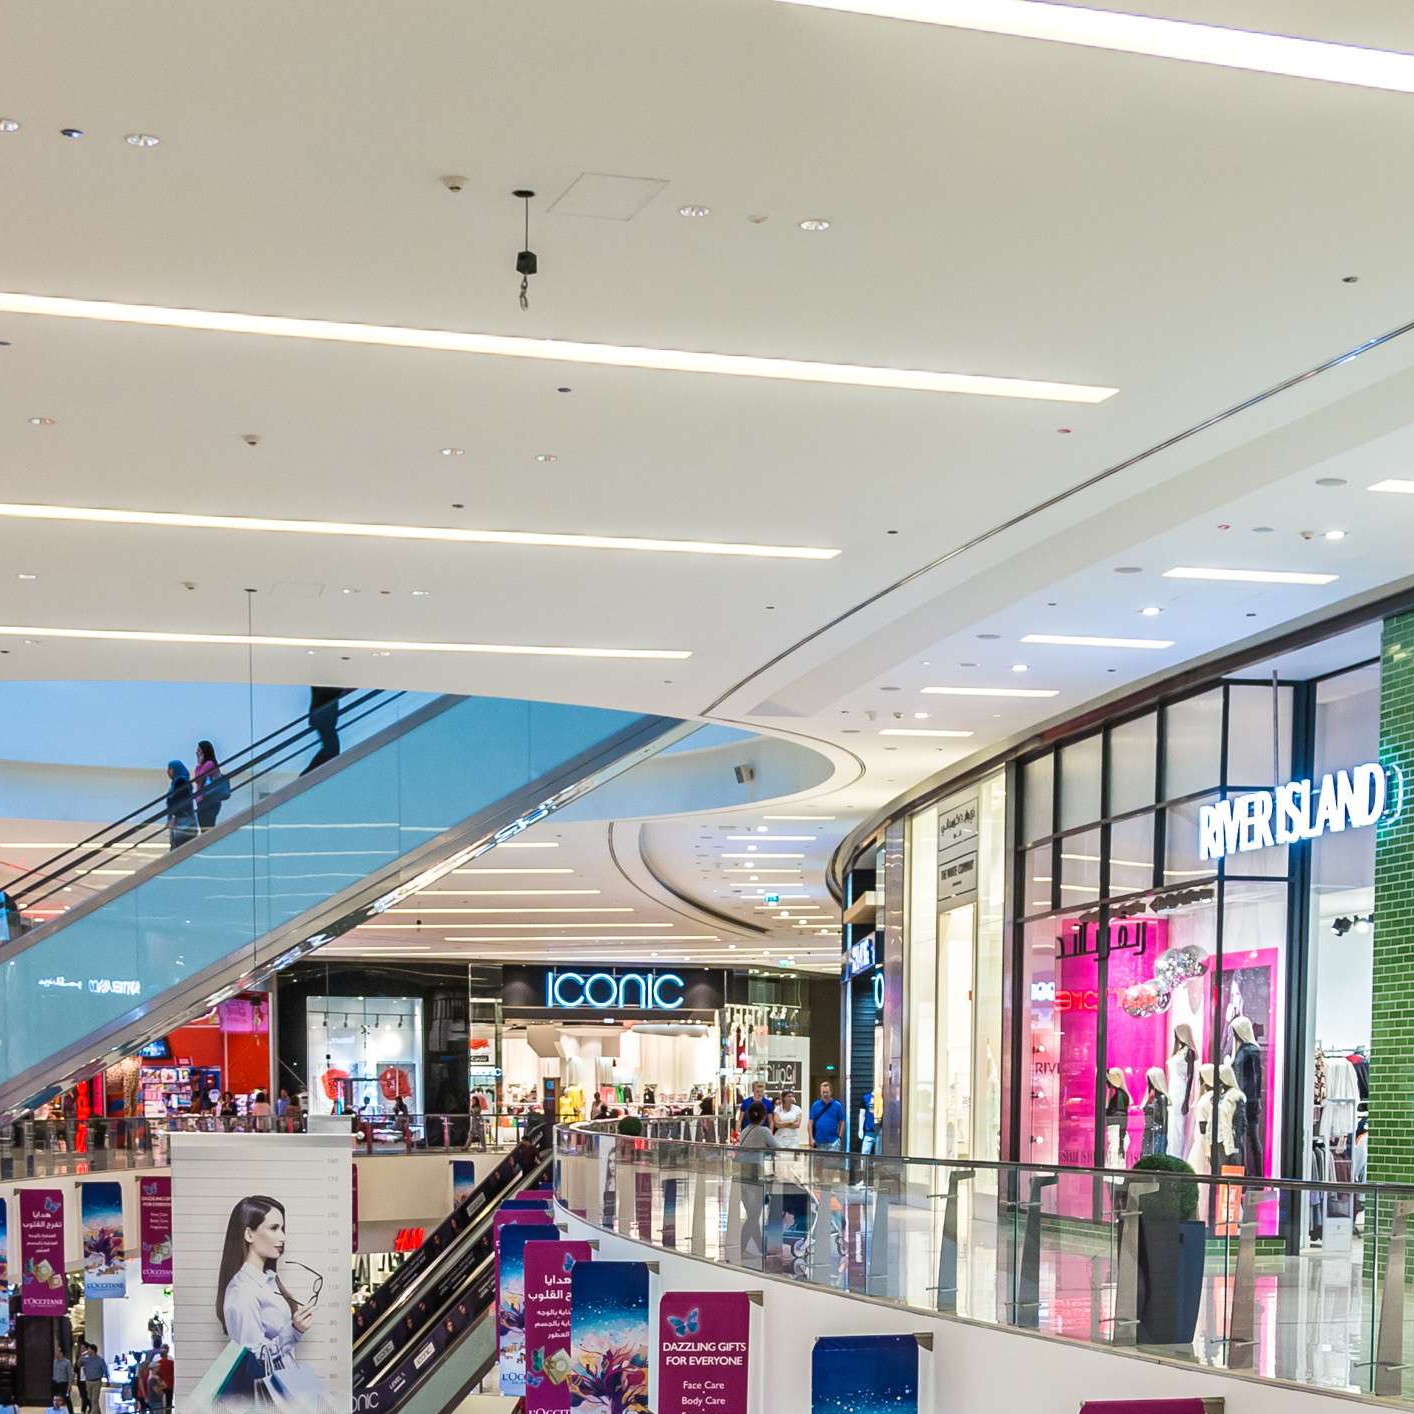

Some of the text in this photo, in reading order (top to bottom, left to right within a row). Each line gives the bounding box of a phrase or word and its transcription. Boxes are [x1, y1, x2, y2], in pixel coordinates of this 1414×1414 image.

[1200, 762, 1385, 859] RIVER ISLAND
[548, 970, 684, 1009] ICONIC
[663, 1342, 746, 1351] DAZZLING GIFTS
[666, 1356, 742, 1365] FOR EVERYONE
[683, 1381, 724, 1389] Face Care
[682, 1396, 725, 1406] Body Care
